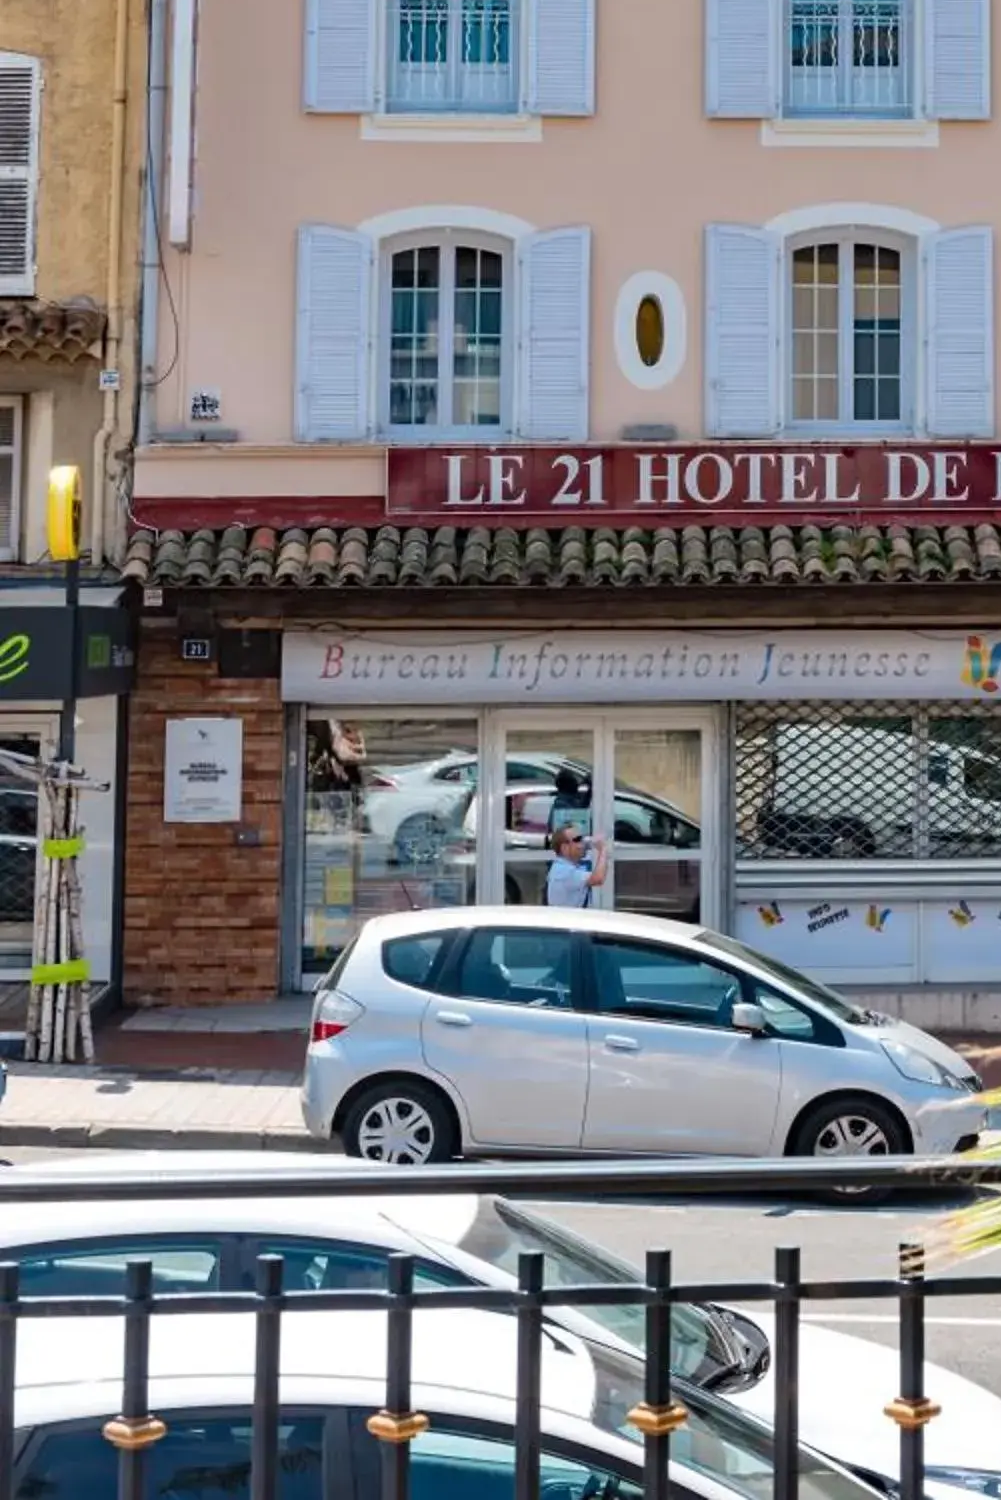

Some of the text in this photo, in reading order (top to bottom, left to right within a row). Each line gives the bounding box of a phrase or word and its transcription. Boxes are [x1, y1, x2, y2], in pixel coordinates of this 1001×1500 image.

[441, 453, 528, 506] LE
[550, 453, 608, 505] 21
[634, 452, 861, 504] HOTEL
[882, 450, 969, 501] DE
[319, 641, 931, 690] Bureau Information Jeunesse
